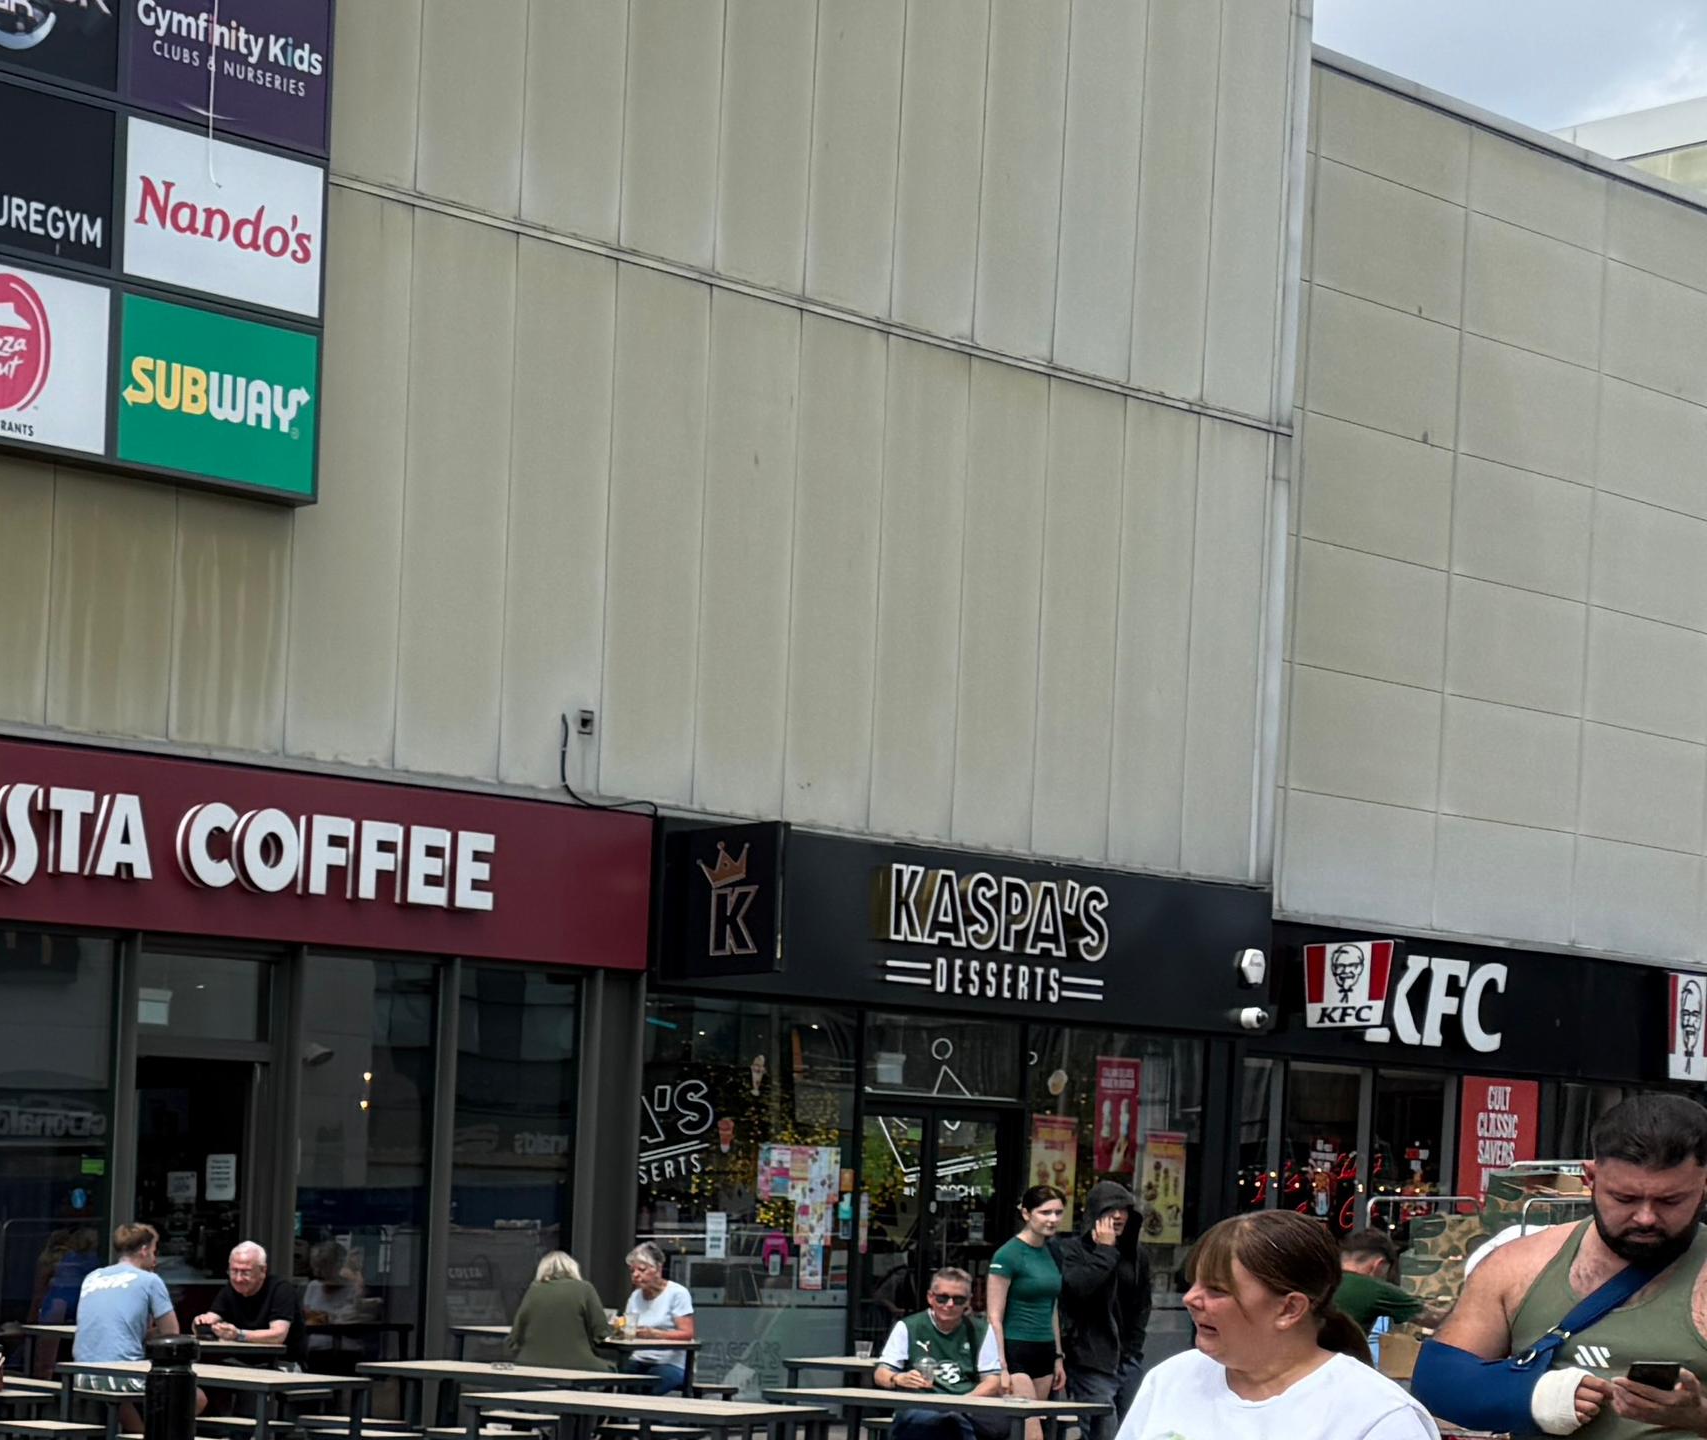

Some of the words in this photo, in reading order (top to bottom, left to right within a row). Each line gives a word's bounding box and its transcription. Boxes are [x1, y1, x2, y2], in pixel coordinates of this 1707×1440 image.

[137, 0, 264, 64] Gymfinity
[269, 34, 323, 75] Kids
[153, 40, 200, 66] CLUBS
[224, 60, 306, 97] NURSERIES
[135, 175, 313, 265] Nando's
[123, 356, 311, 433] SUBWAY
[176, 801, 496, 912] COFFEE
[708, 884, 759, 957] K
[887, 862, 1110, 962] KASPA'S
[935, 956, 1060, 1004] DESSERTS
[1316, 1004, 1374, 1025] KFC
[1364, 955, 1509, 1053] KFC
[1476, 1111, 1520, 1140] CLASSIC
[1487, 1085, 1512, 1112] CULT
[1477, 1139, 1516, 1167] SAVERS
